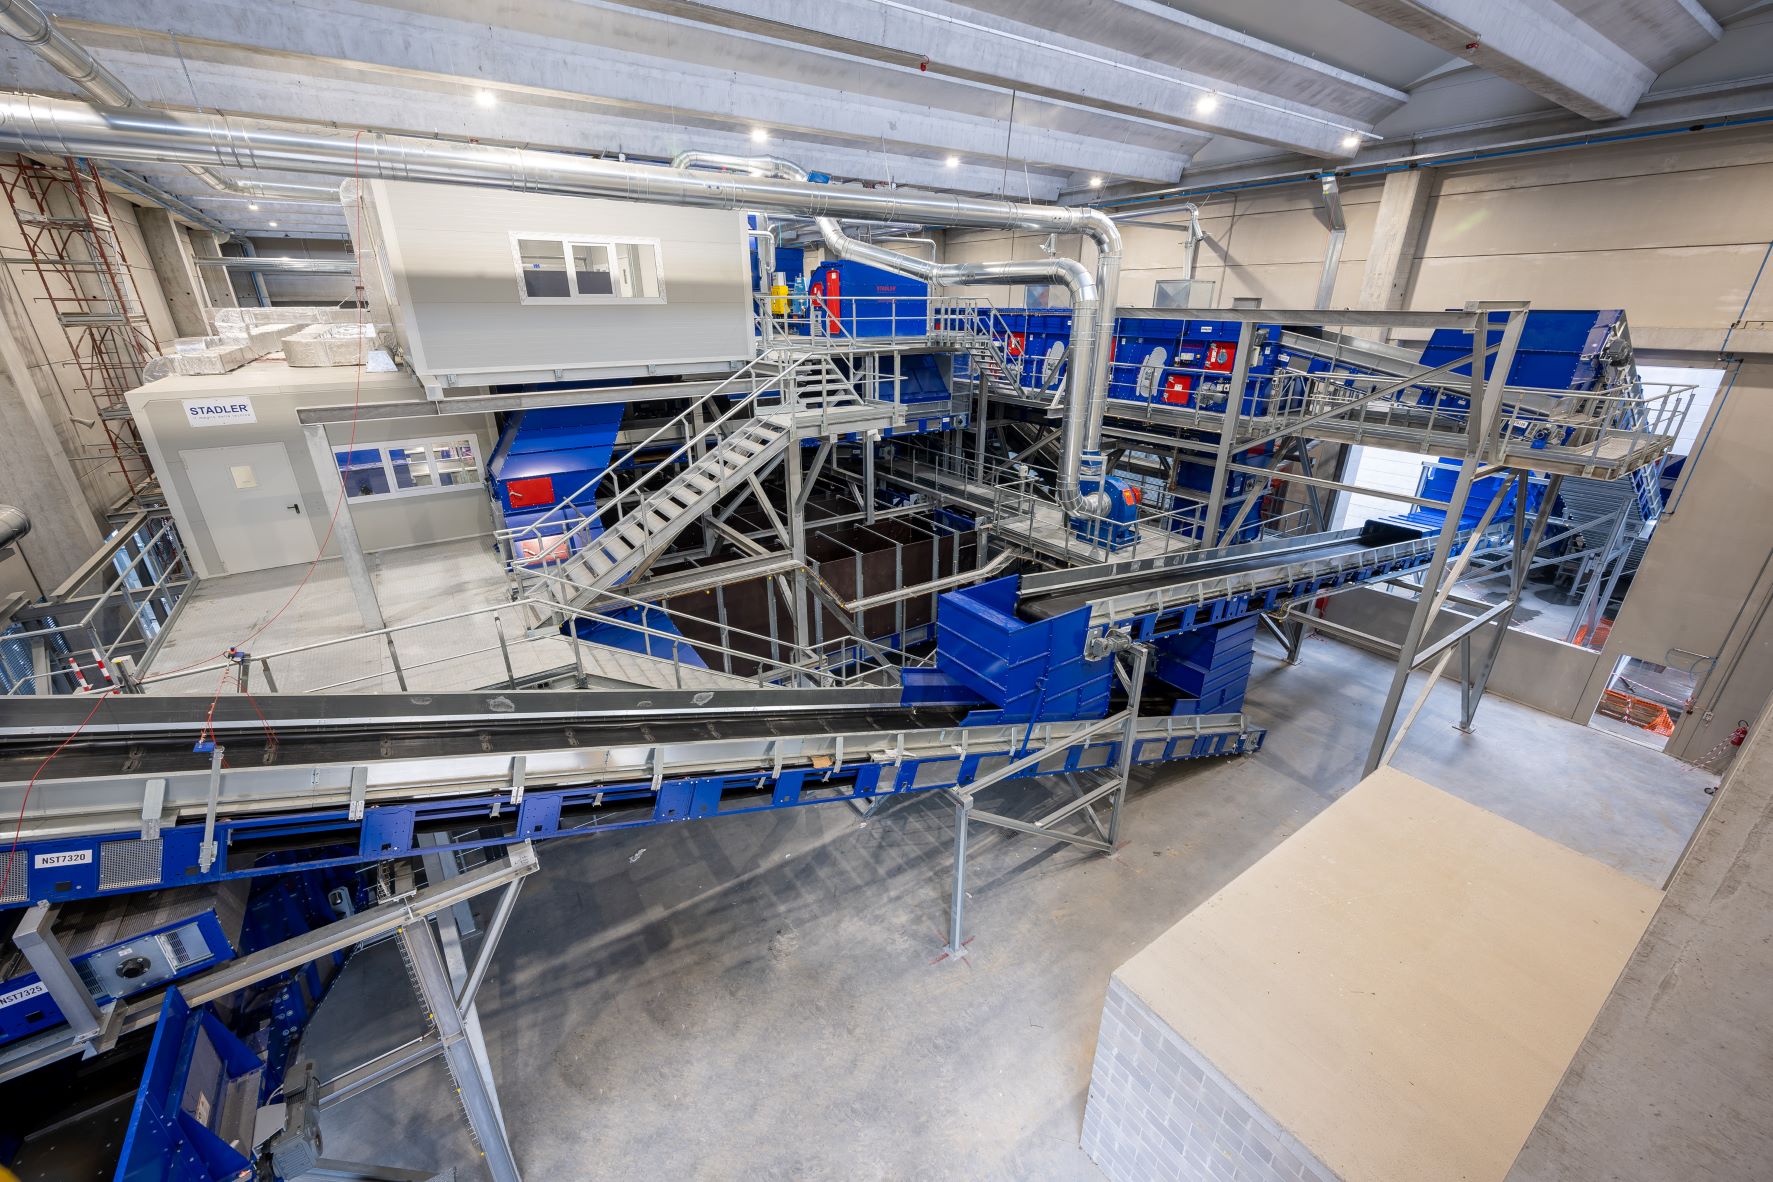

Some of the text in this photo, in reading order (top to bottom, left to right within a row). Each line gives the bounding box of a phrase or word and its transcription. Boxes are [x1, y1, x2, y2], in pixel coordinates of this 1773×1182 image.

[189, 404, 248, 416] STADLER
[42, 853, 86, 865] NST7320
[0, 985, 43, 1005] NST7325
